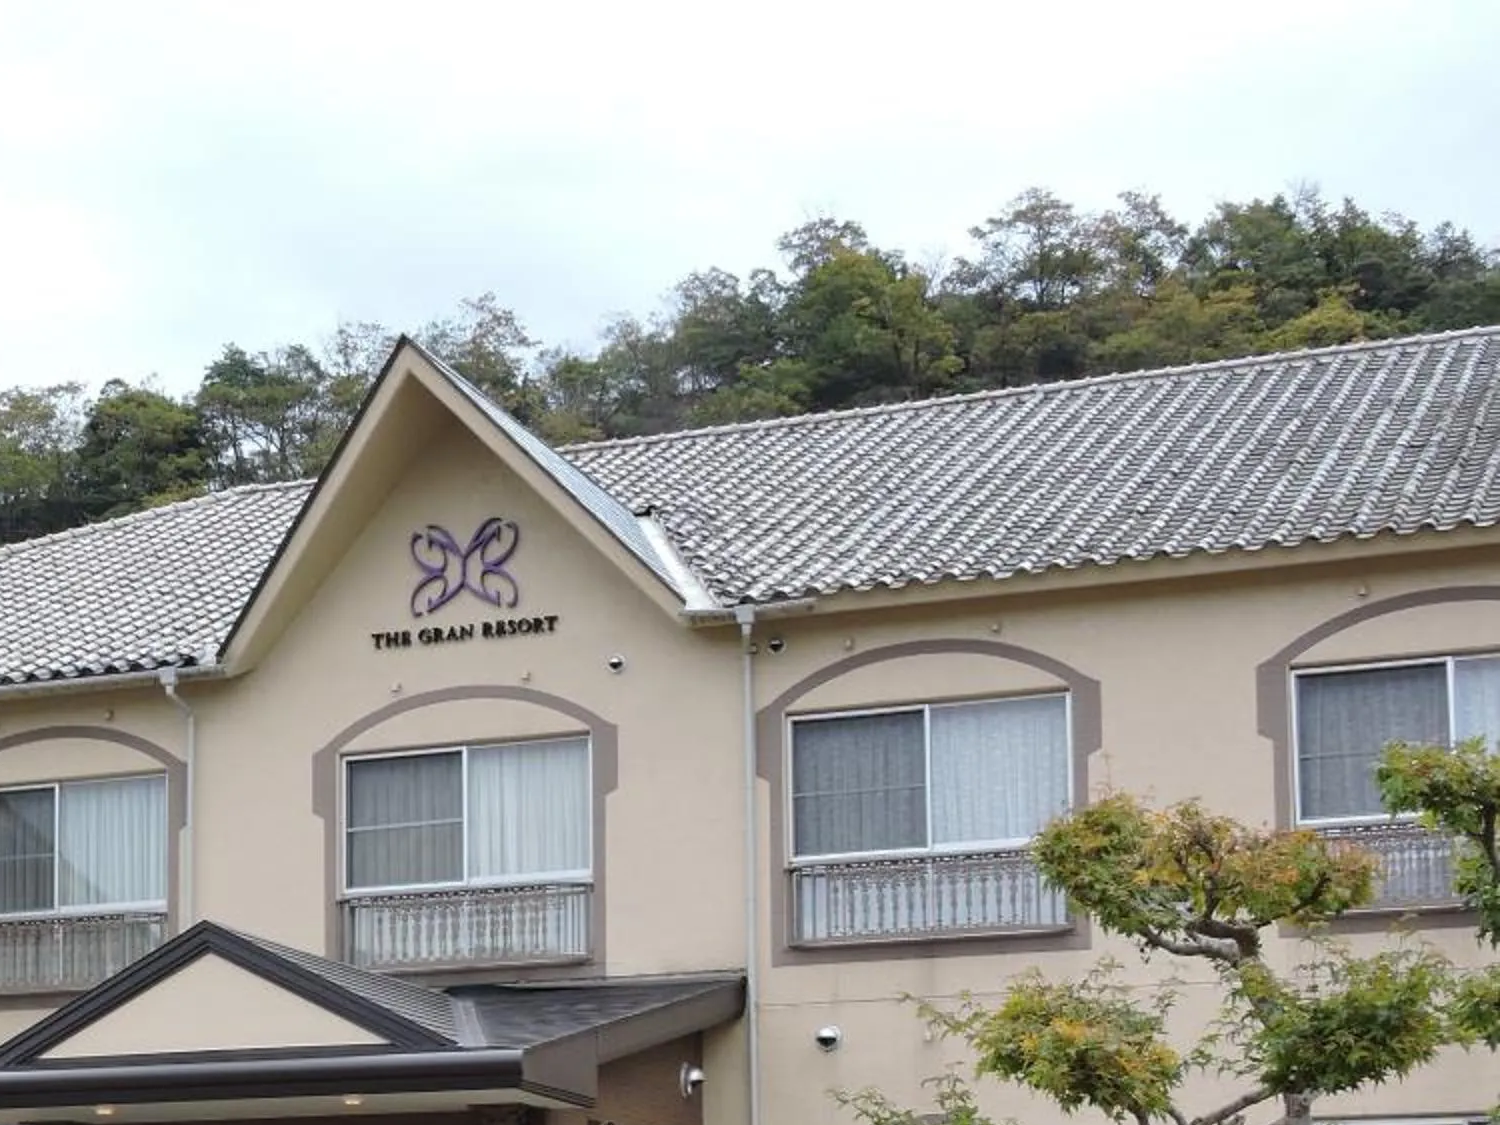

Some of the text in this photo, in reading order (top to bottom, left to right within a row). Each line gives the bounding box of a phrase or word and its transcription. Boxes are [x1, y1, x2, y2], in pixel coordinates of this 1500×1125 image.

[371, 615, 559, 650] THE GRAN RESORT
